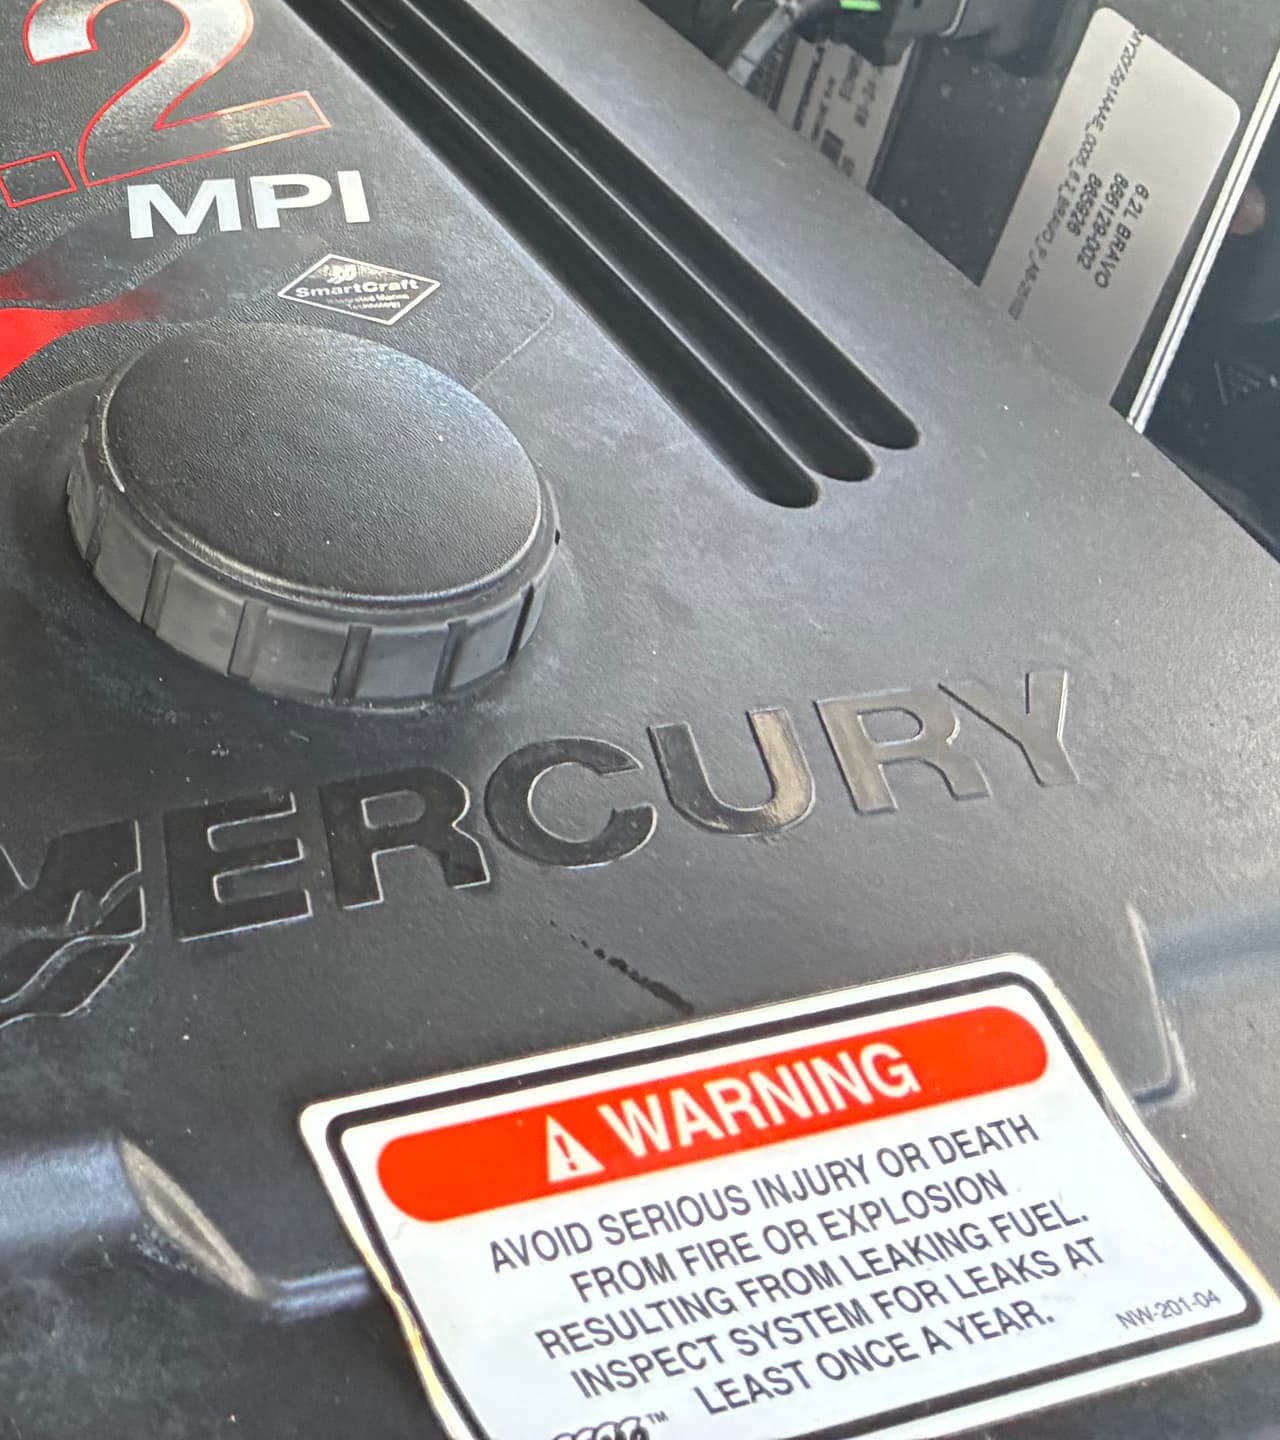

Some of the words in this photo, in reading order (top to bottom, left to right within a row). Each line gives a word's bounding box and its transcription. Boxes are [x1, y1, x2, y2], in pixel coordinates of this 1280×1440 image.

[126, 169, 370, 239] MPI
[1093, 222, 1132, 290] BRAVO
[295, 278, 420, 298] SmartCraft
[597, 1042, 922, 1159] WARNING
[488, 1220, 594, 1274] AVOID
[597, 1183, 752, 1246] SERIOUS
[752, 1153, 872, 1209] INJURY
[875, 1141, 929, 1178] OR
[928, 1114, 1040, 1165] DEATH
[570, 1252, 677, 1304] FROM
[676, 1231, 762, 1277] FIRE
[762, 1218, 818, 1256] OR
[816, 1168, 1009, 1244] EXPLOSION
[533, 1286, 738, 1360] RESULTING
[734, 1260, 842, 1309] FROM
[839, 1221, 991, 1284] LEAKING
[991, 1197, 1090, 1246] FUEL.
[570, 1333, 727, 1400] INSPECT
[728, 1297, 874, 1358] SYSTEM
[871, 1277, 951, 1322] FOR
[947, 1248, 1061, 1301] LEAKS
[1057, 1235, 1106, 1275] AT
[1114, 1288, 1223, 1330] NW-201-04
[693, 1359, 813, 1416] LEAST
[815, 1330, 922, 1384] ONCE
[925, 1324, 953, 1356] A
[951, 1296, 1056, 1349] YEAR.
